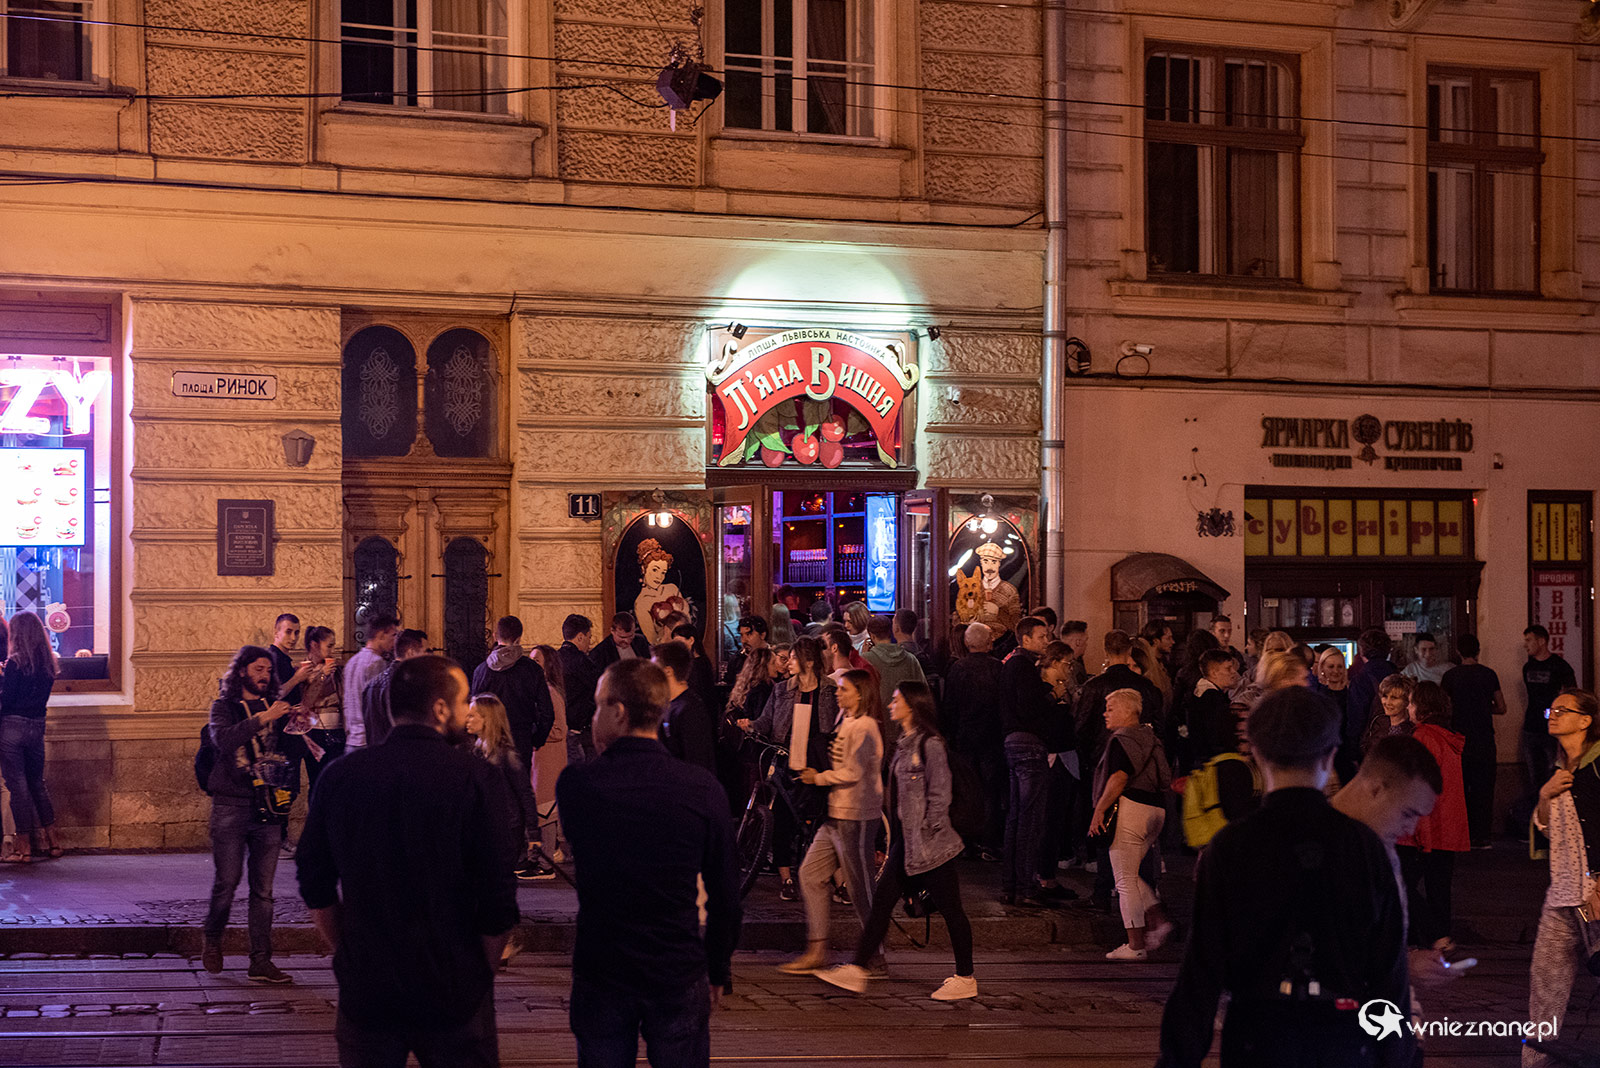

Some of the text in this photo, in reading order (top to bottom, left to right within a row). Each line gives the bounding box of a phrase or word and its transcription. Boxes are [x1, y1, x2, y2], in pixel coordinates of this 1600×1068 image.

[747, 338, 778, 359] ЛІПША
[781, 329, 831, 343] ЛЬВІВСЬКА
[216, 378, 268, 396] РИНОК
[1261, 416, 1474, 453] ЯРМАРКА СУВЕНІРІВ
[575, 495, 596, 515] 11
[1247, 505, 1459, 545] сувеніри
[1539, 573, 1576, 584] ПРОДАЖ
